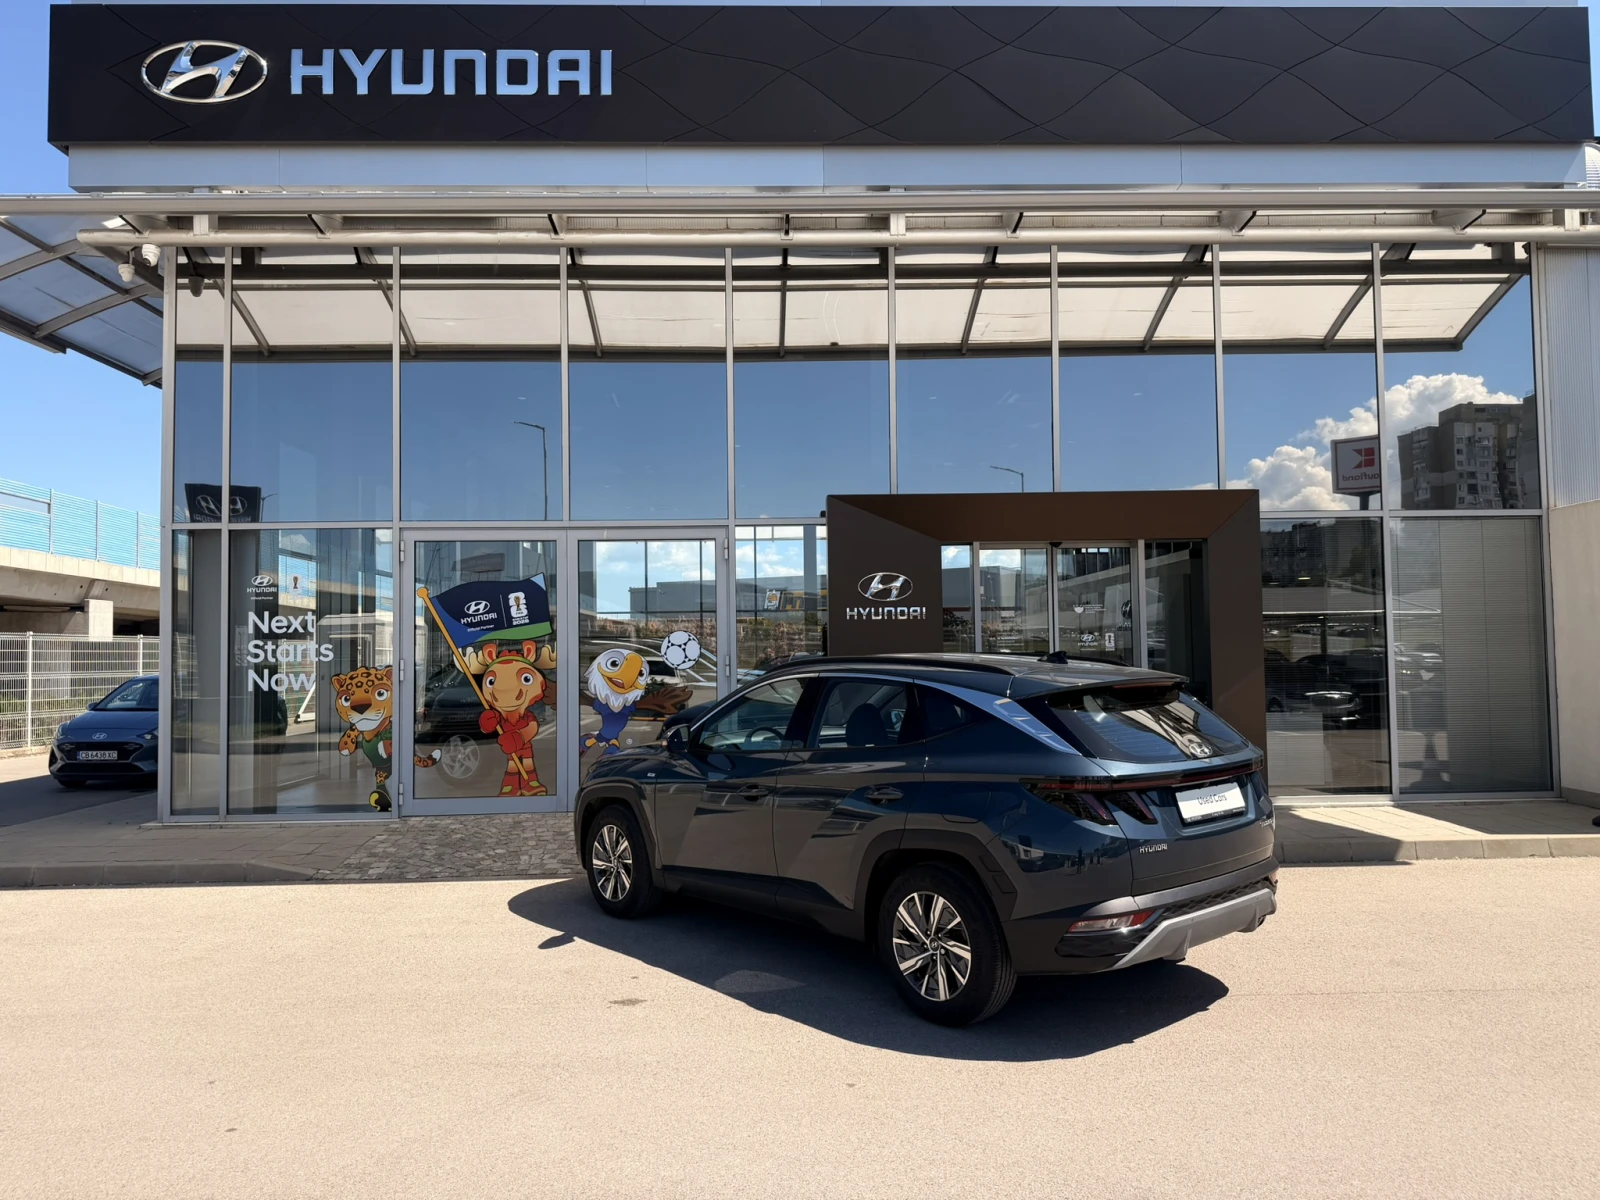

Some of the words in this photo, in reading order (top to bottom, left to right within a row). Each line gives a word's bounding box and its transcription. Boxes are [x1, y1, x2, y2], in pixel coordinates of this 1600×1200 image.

[290, 48, 612, 96] HYUNDAI
[460, 612, 498, 625] HYUNDAI
[846, 606, 926, 620] HYUNDAI
[248, 611, 316, 634] Next
[247, 640, 334, 663] Starts
[248, 669, 316, 692] Now
[1196, 794, 1213, 806] Used
[1213, 793, 1228, 803] Cars
[1139, 843, 1168, 854] HYUNDAI
